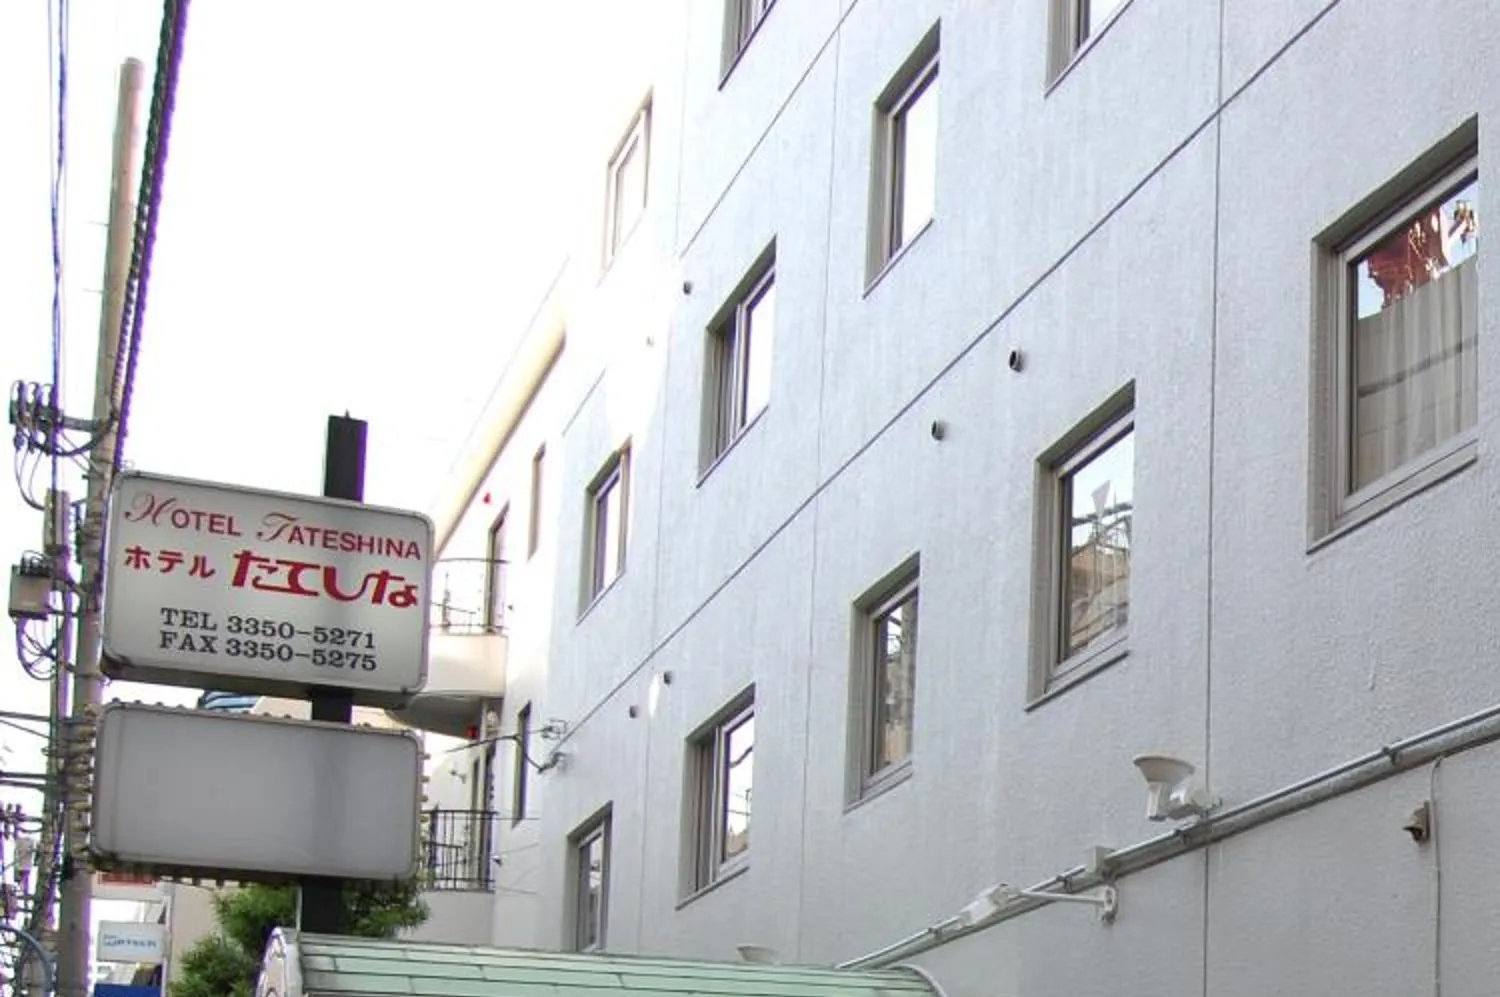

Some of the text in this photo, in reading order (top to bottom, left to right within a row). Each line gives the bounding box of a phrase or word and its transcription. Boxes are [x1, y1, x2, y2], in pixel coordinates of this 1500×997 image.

[125, 494, 421, 560] HOTEL TATESHINA
[124, 545, 419, 609] ホテル たてしな
[160, 607, 376, 649] TEL 3350-5271
[160, 630, 377, 672] FAX 3350-5275
